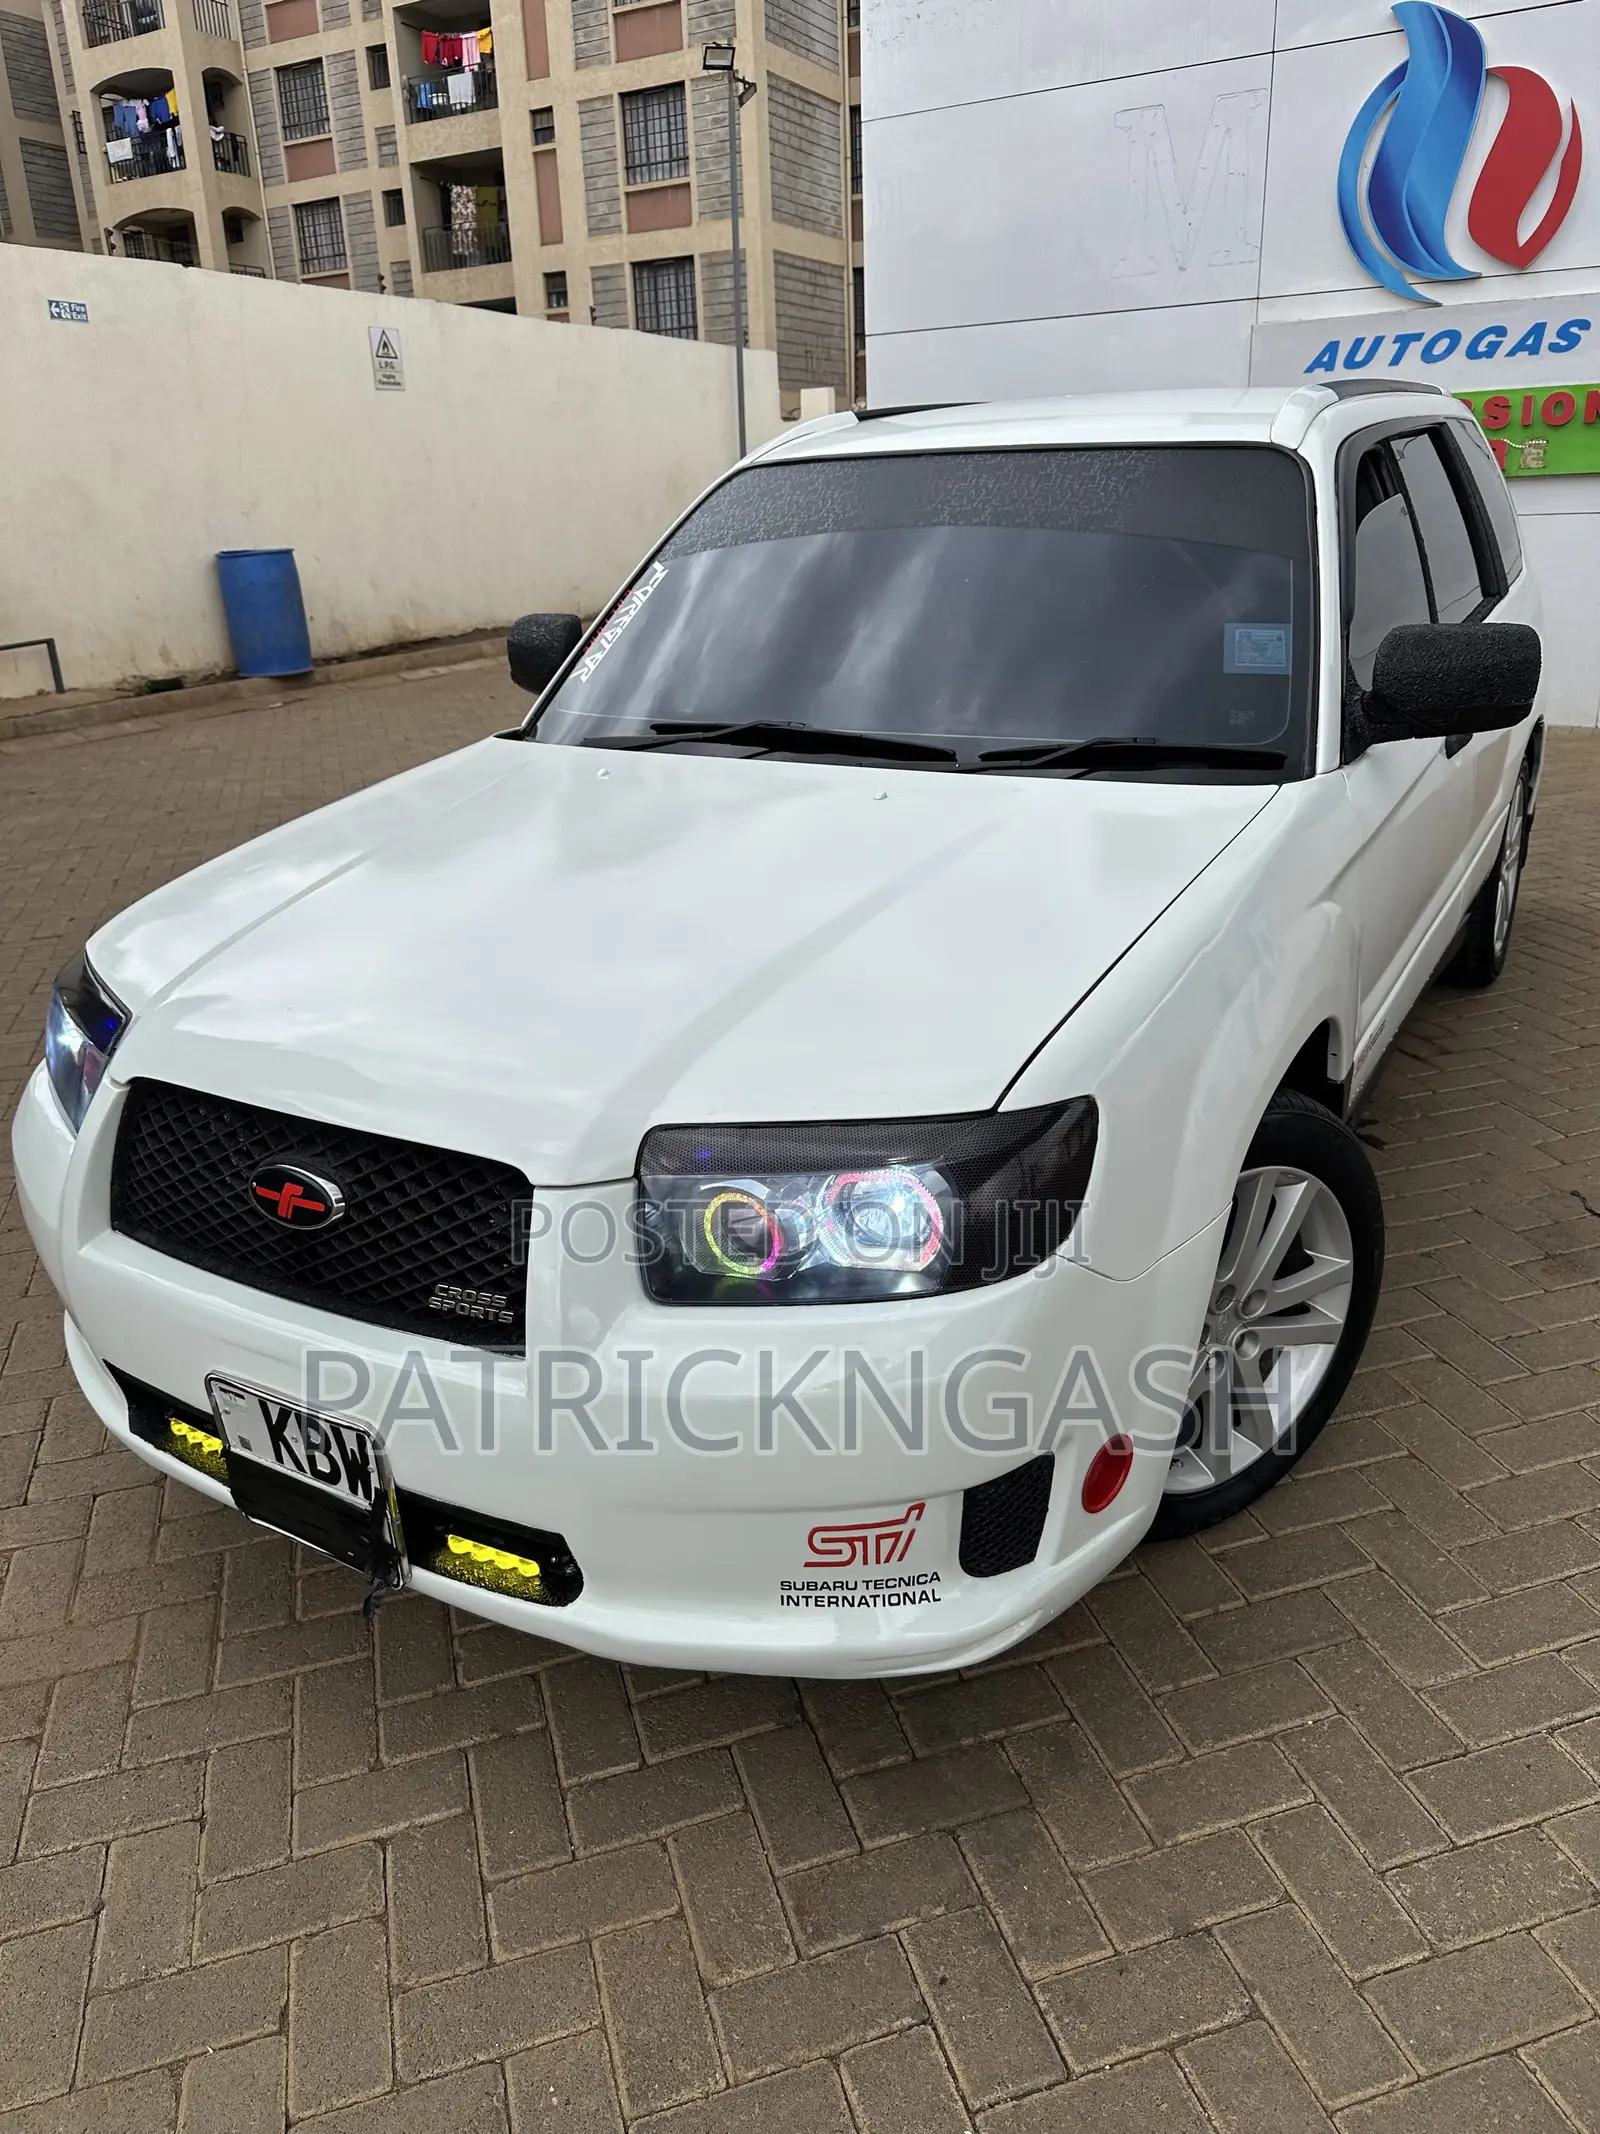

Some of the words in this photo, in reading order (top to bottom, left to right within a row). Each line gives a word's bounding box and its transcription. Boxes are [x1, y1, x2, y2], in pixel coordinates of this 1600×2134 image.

[70, 303, 86, 313] Fire
[72, 311, 87, 321] Exit
[1303, 318, 1592, 374] AUTOGAS
[570, 560, 670, 684] FORESTER
[434, 1283, 508, 1308] CROSS
[428, 1296, 515, 1324] SPORTS
[257, 1398, 373, 1501] KBW
[780, 1580, 858, 1591] SUBARU
[862, 1571, 941, 1590] TECNICA
[780, 1588, 942, 1608] INTERNATIONAL
